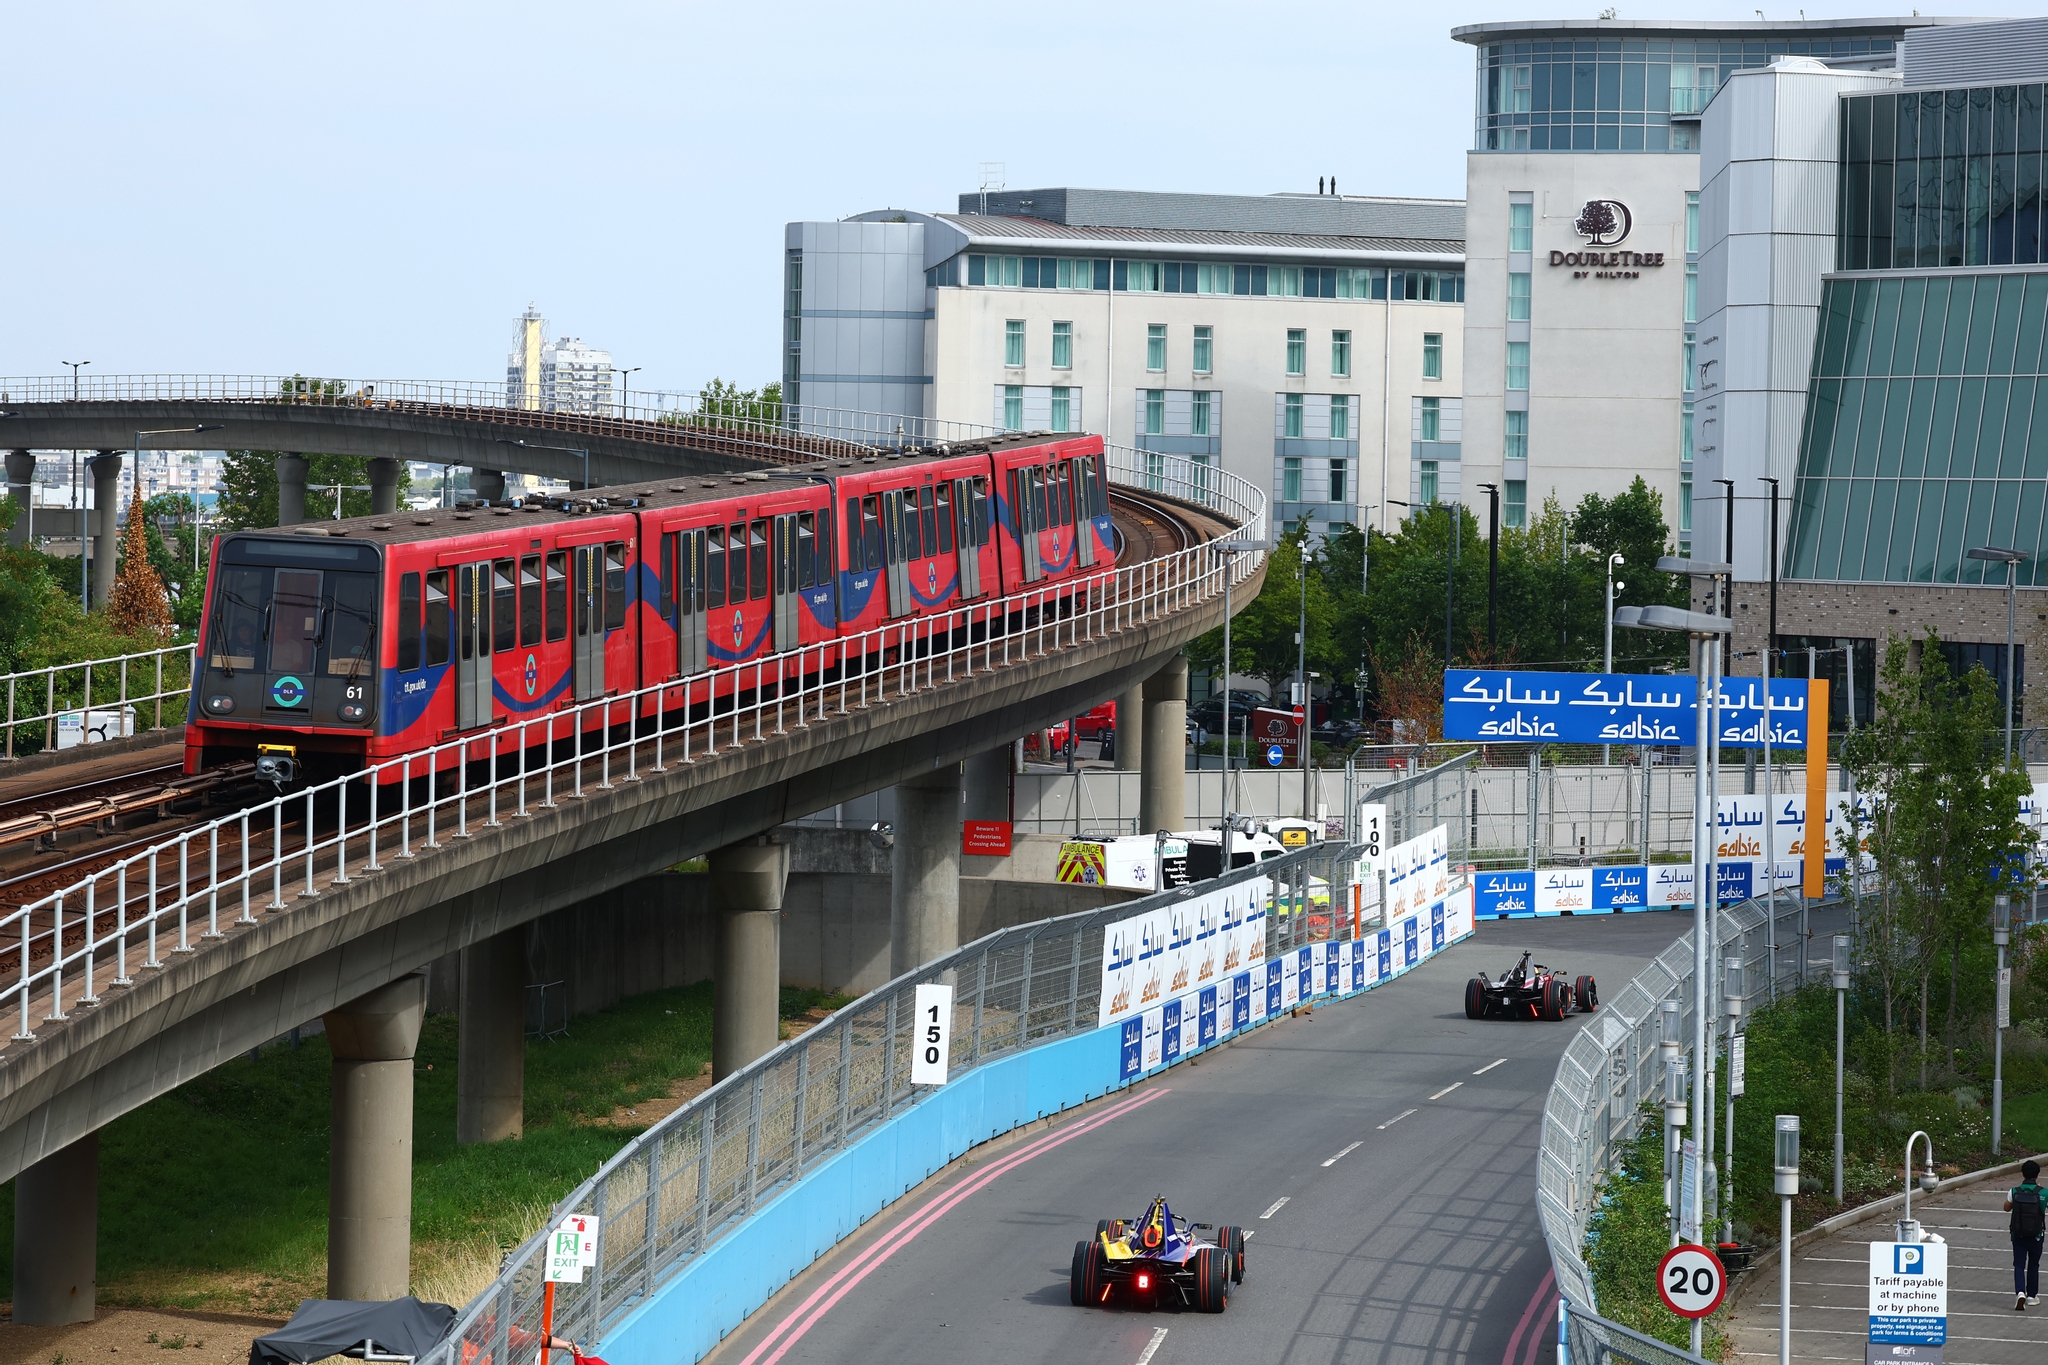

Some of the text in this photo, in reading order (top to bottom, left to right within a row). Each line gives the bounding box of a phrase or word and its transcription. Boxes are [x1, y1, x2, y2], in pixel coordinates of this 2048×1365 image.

[1574, 271, 1640, 279] BY HILTON
[346, 686, 362, 699] 61
[1478, 710, 1559, 736] sabic
[1598, 714, 1680, 740] sabic
[1720, 717, 1802, 744] sabic
[1370, 817, 1379, 857] 100
[1063, 844, 1100, 854] AMBULANCE
[1610, 889, 1640, 904] sabic
[1666, 887, 1692, 902] sabic
[1718, 884, 1744, 899] sabic
[1495, 896, 1526, 911] sabic
[1554, 892, 1584, 907] sabic
[925, 1005, 940, 1064] 150
[554, 1258, 579, 1267] EXIT
[1899, 1247, 1920, 1273] P
[1669, 1266, 1714, 1296] 20
[1874, 1277, 1944, 1288] Tariff payable
[1893, 1291, 1937, 1300] machine
[1892, 1303, 1904, 1313] by
[1907, 1304, 1939, 1314] phone
